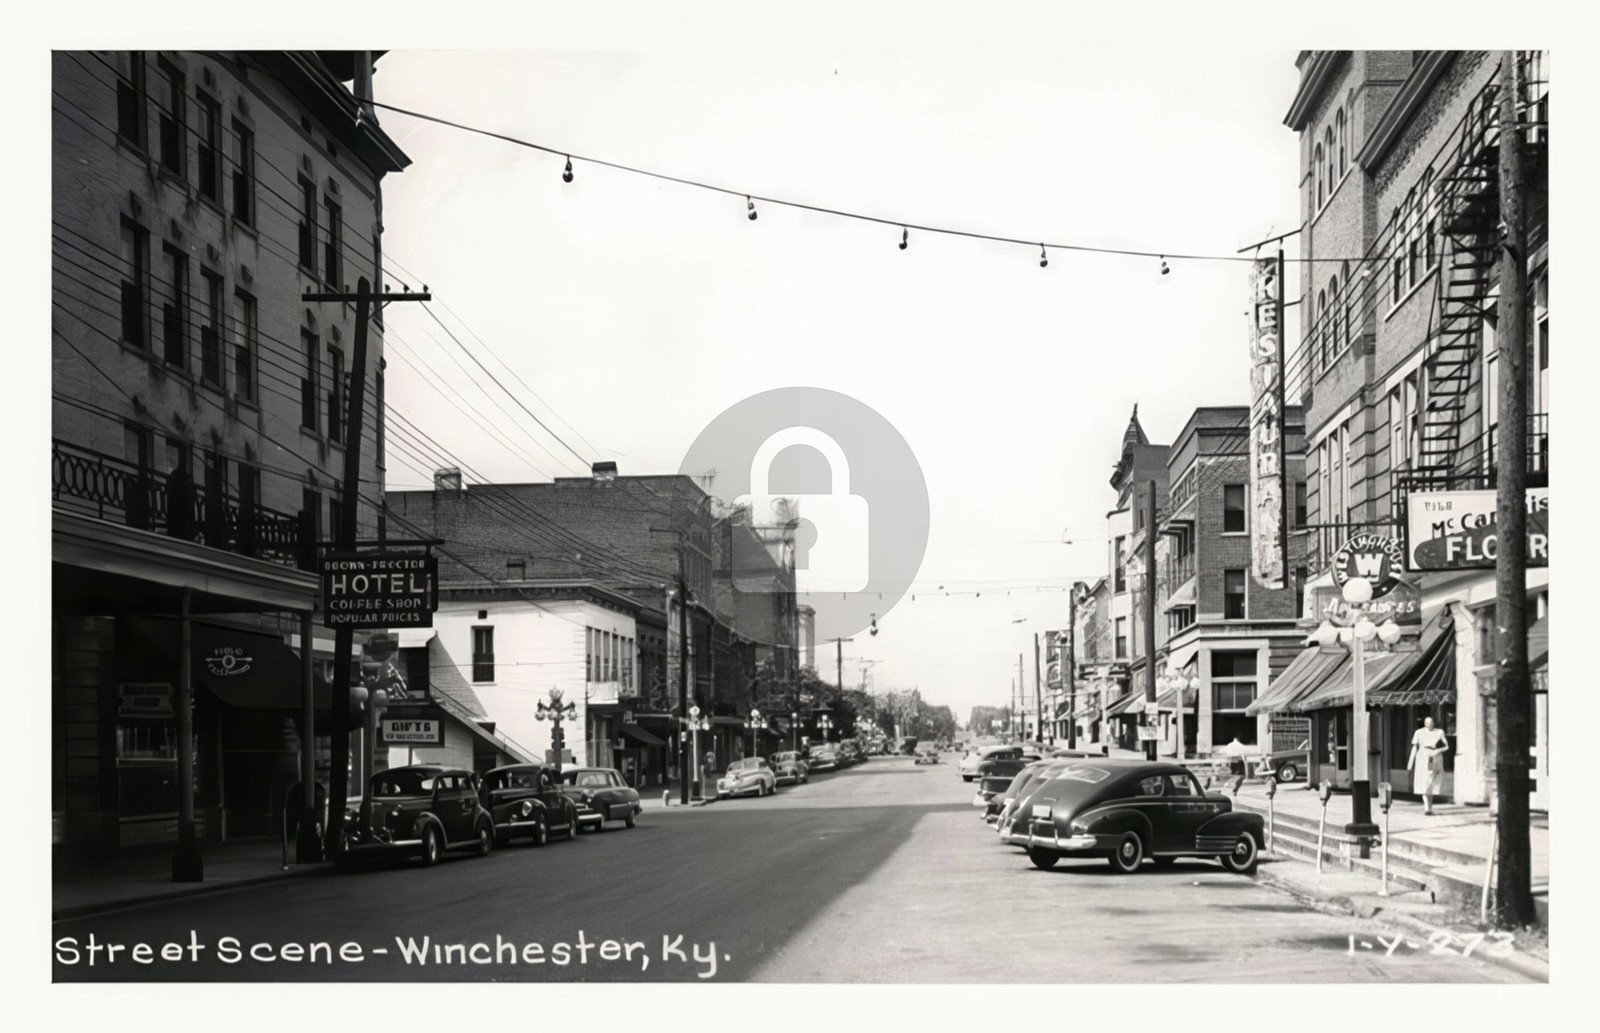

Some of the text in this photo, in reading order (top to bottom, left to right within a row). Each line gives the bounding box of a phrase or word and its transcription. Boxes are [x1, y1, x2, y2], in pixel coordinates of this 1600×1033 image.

[1446, 534, 1548, 562] FLOR
[331, 573, 425, 595] HOTEL
[387, 598, 421, 609] SHOP
